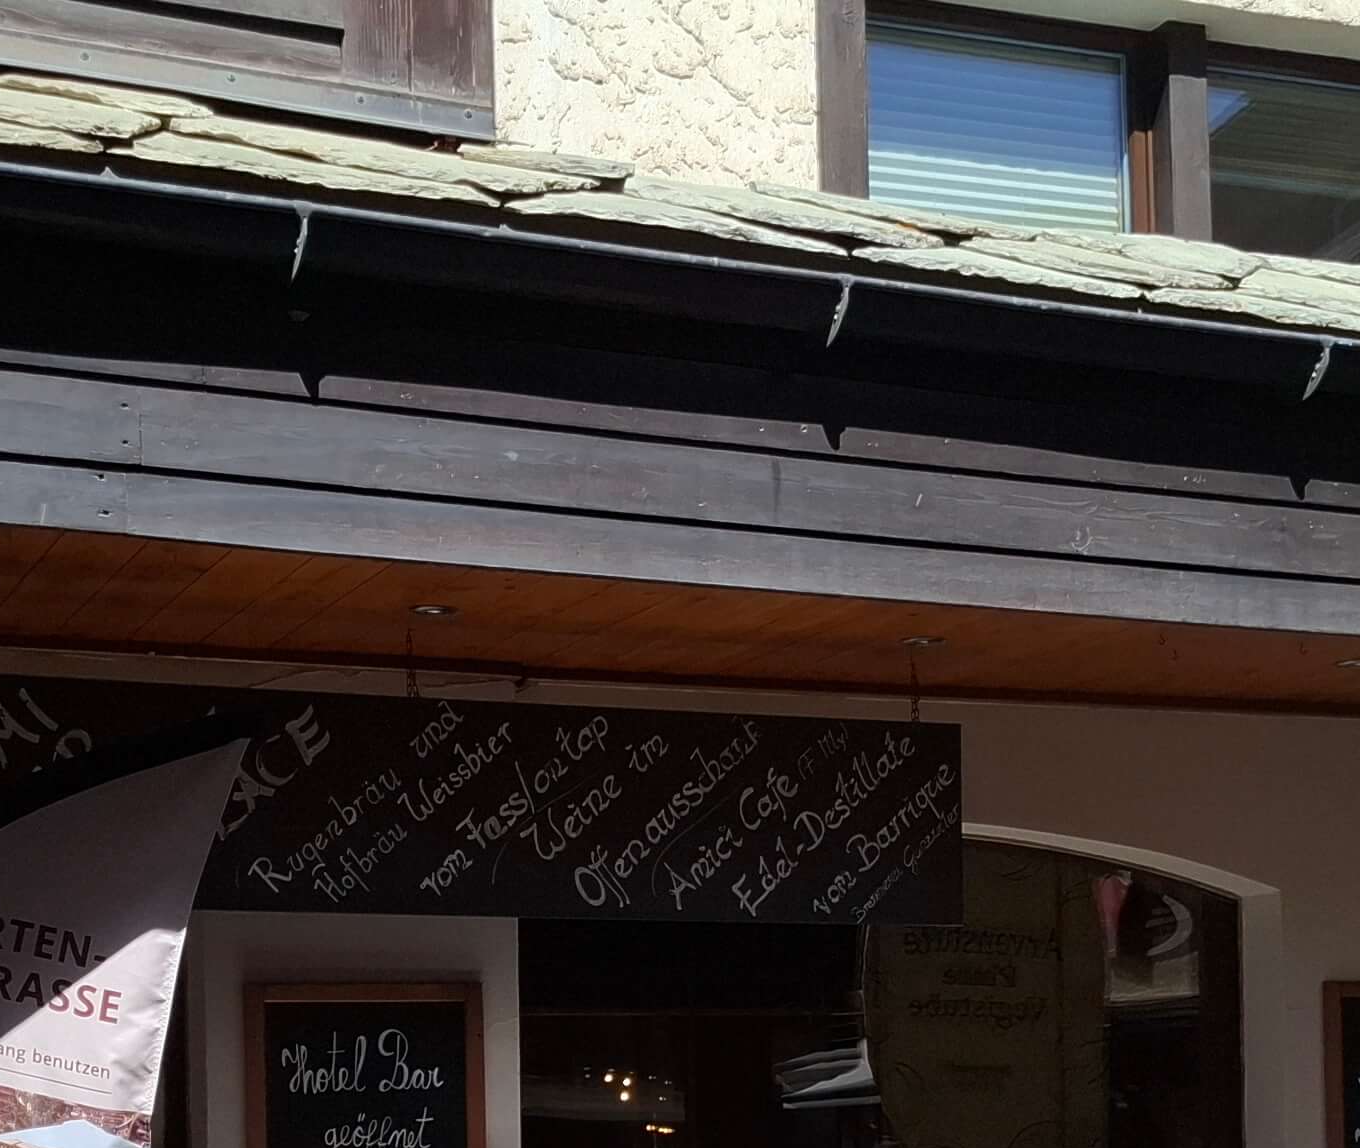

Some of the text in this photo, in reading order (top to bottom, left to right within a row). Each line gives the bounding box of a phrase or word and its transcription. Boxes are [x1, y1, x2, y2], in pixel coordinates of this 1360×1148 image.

[248, 700, 465, 894] Rugenbräu und
[312, 721, 514, 904] Hofbräu Weissbier
[420, 848, 473, 897] vom
[555, 714, 610, 762] tap
[520, 733, 670, 862] Weine im
[846, 763, 957, 872] Barrique
[667, 823, 744, 911] Amici
[32, 1047, 111, 1080] benutzen
[281, 1028, 445, 1096] Hotel Bar
